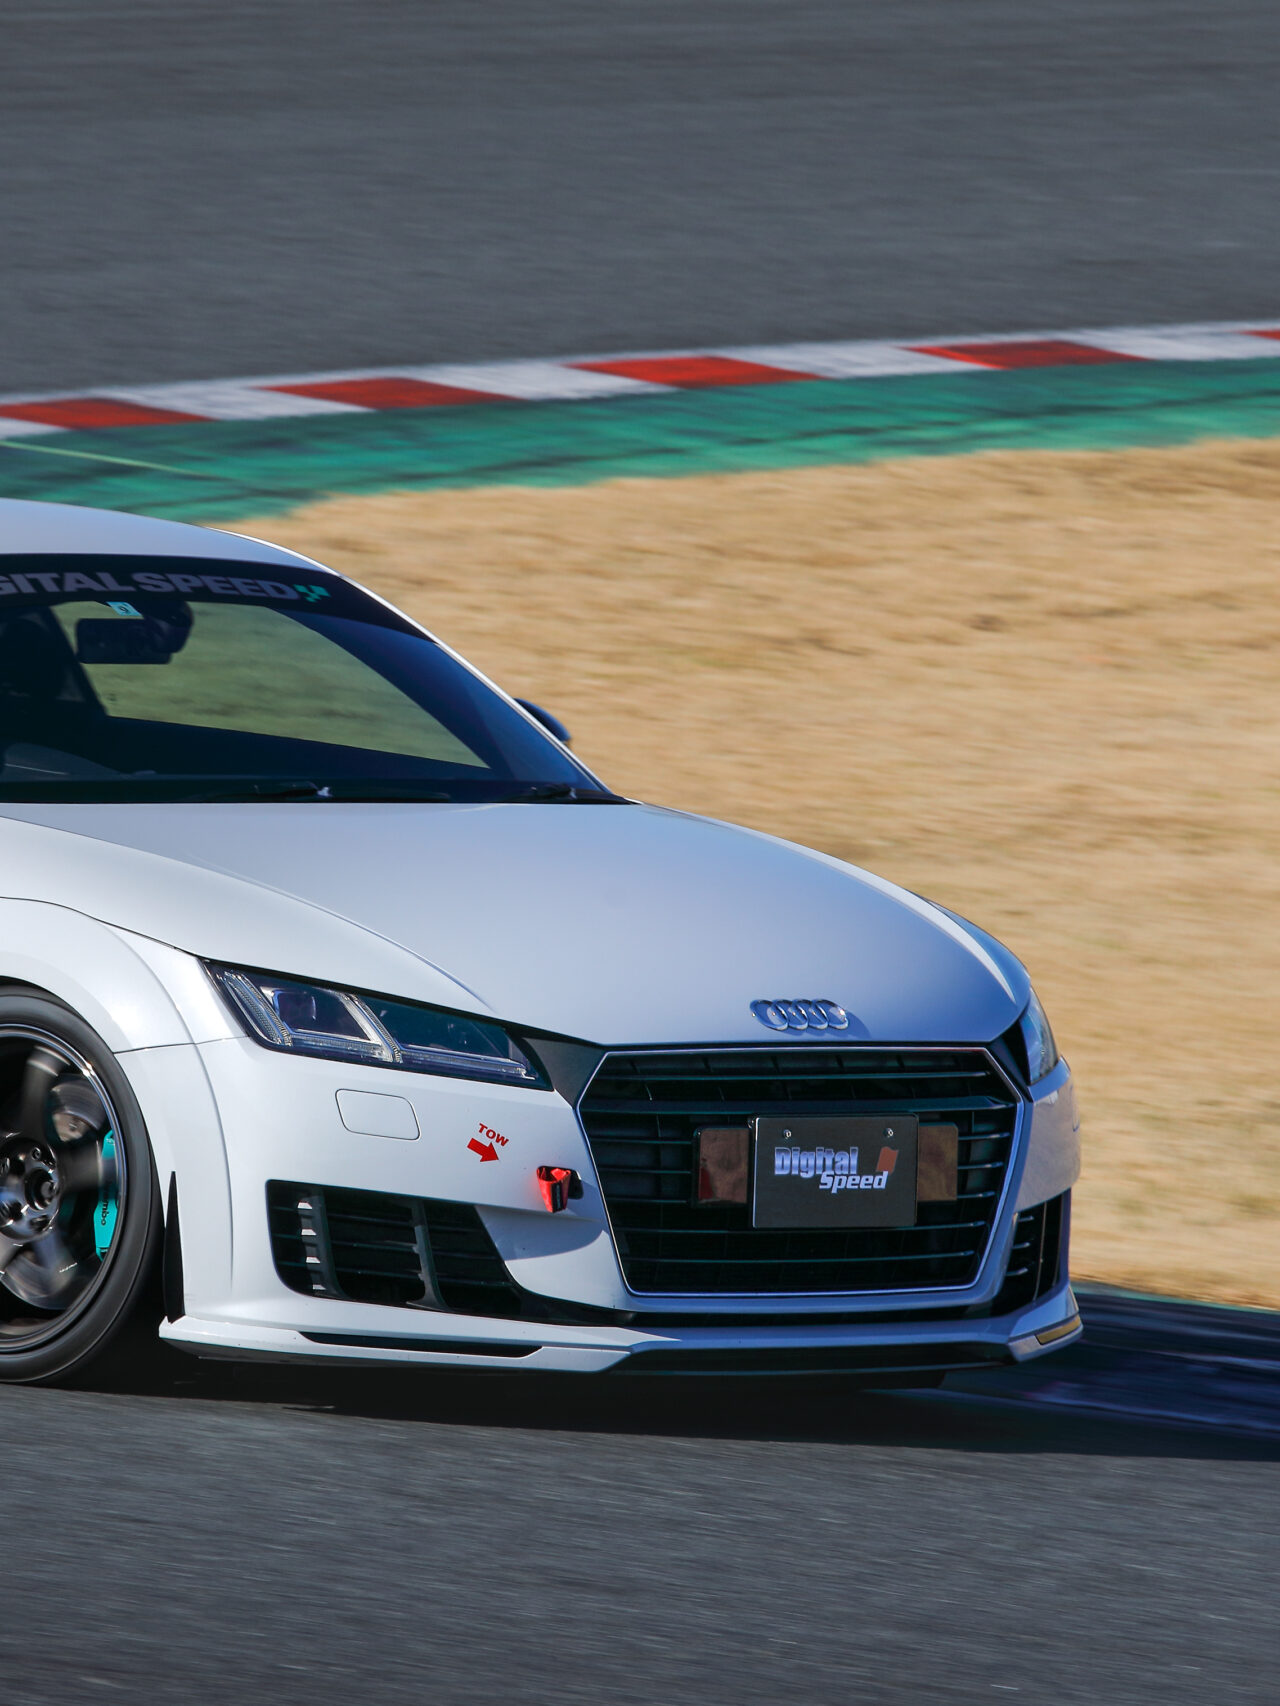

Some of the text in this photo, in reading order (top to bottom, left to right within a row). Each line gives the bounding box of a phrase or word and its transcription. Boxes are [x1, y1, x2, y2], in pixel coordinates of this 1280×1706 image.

[129, 572, 300, 600] SPEED
[478, 1122, 509, 1147] TOW
[774, 1147, 859, 1179] Digital
[819, 1170, 889, 1194] Speed
